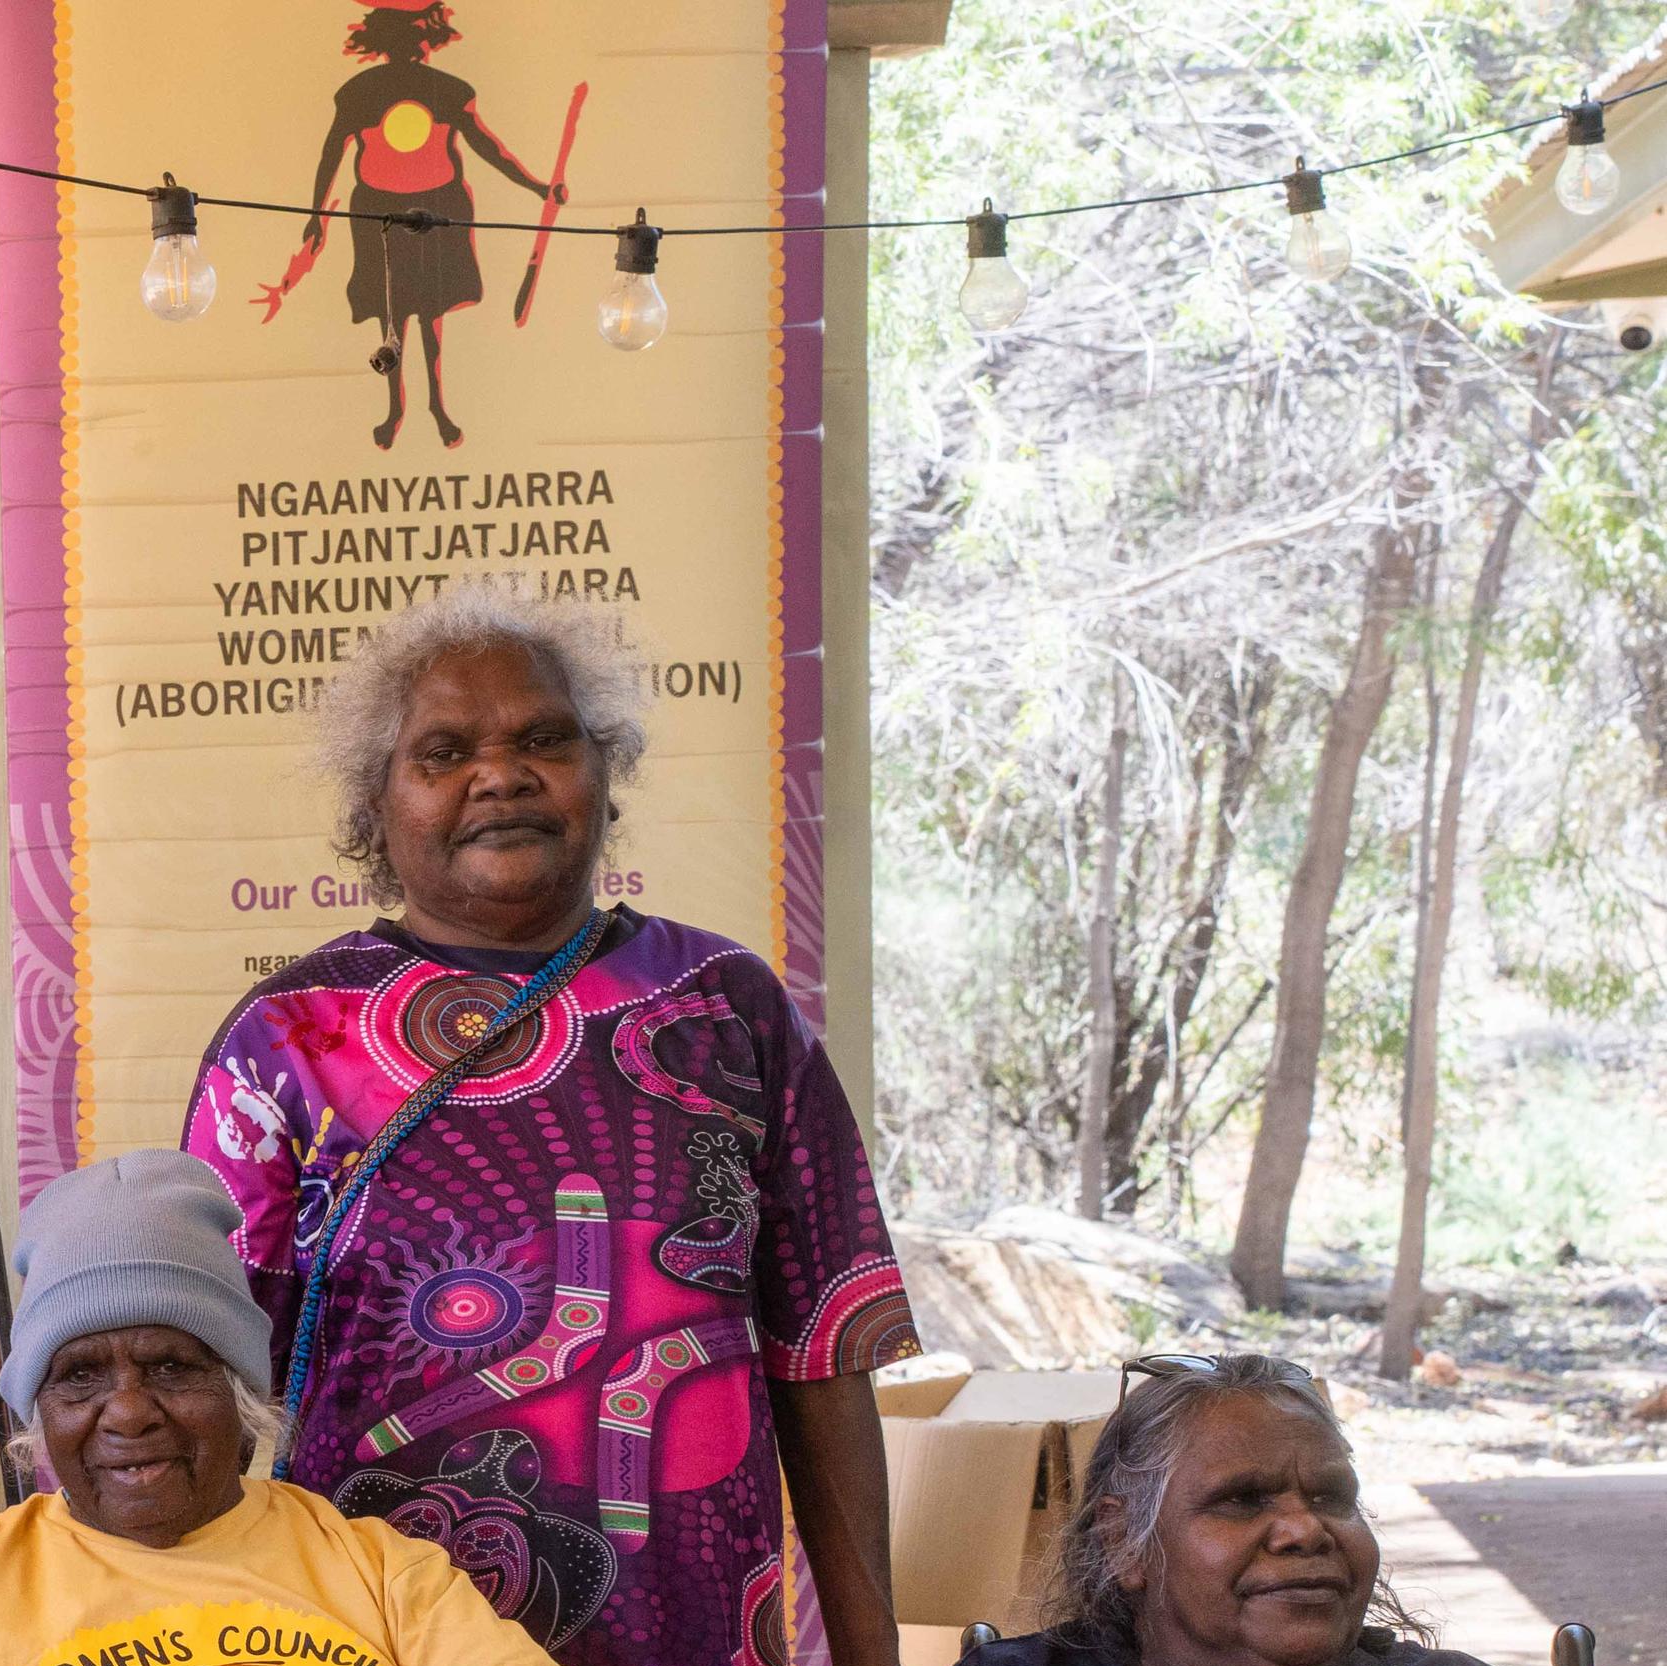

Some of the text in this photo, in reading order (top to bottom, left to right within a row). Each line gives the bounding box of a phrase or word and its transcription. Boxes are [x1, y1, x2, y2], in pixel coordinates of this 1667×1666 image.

[237, 470, 614, 518] NGAANYATJARRA
[242, 519, 611, 567] PITJANTJATJARA
[231, 878, 298, 911] Our
